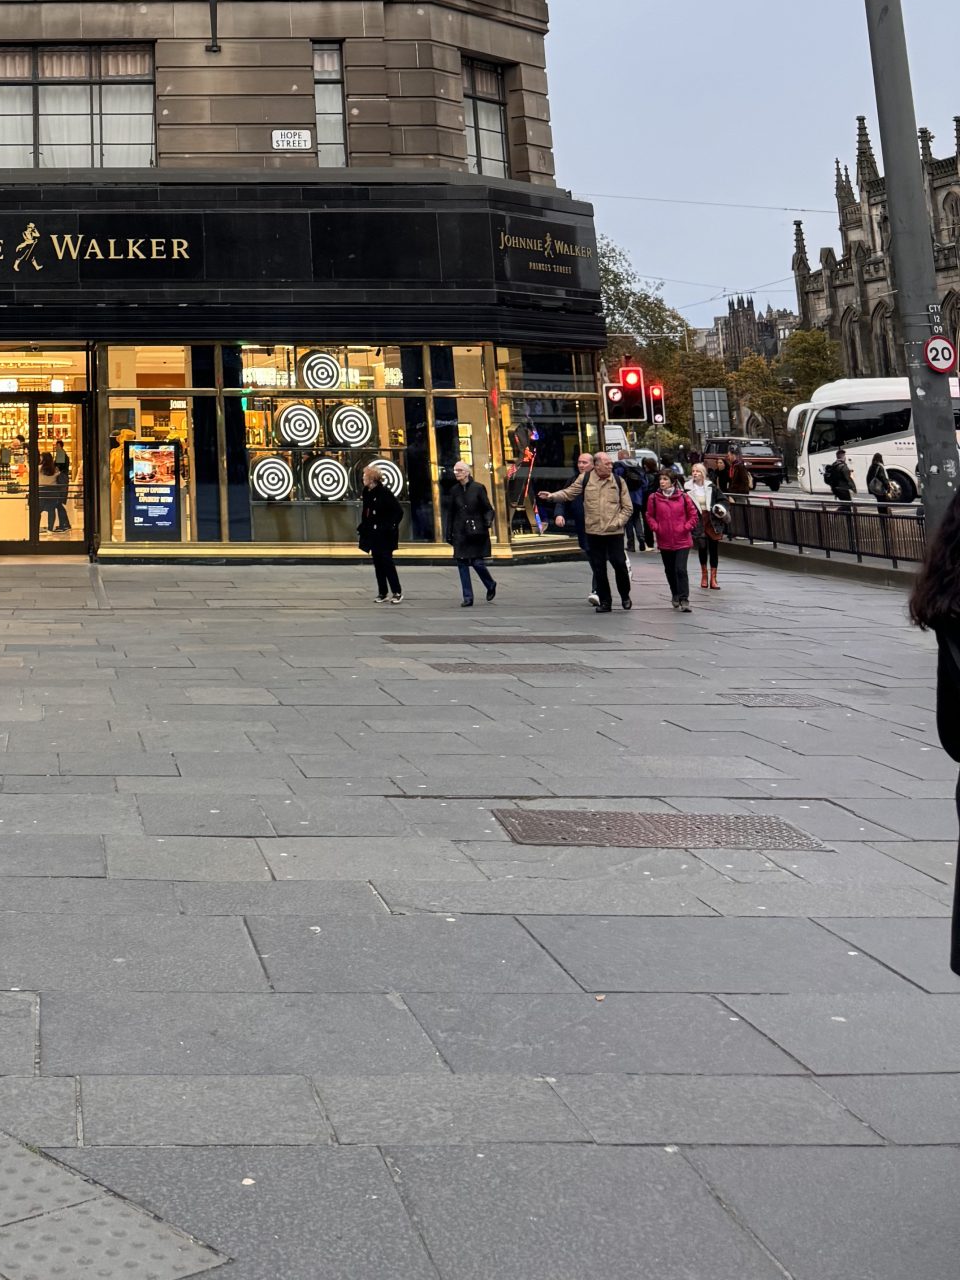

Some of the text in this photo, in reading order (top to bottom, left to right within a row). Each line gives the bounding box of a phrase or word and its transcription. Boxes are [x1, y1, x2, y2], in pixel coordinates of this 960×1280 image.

[280, 131, 303, 139] HOPE
[275, 139, 308, 148] STREET
[50, 234, 190, 260] WALKER
[499, 231, 592, 258] JOHNNIE WALKER
[928, 304, 941, 313] CTY
[933, 325, 943, 333] 09
[929, 346, 952, 362] 20
